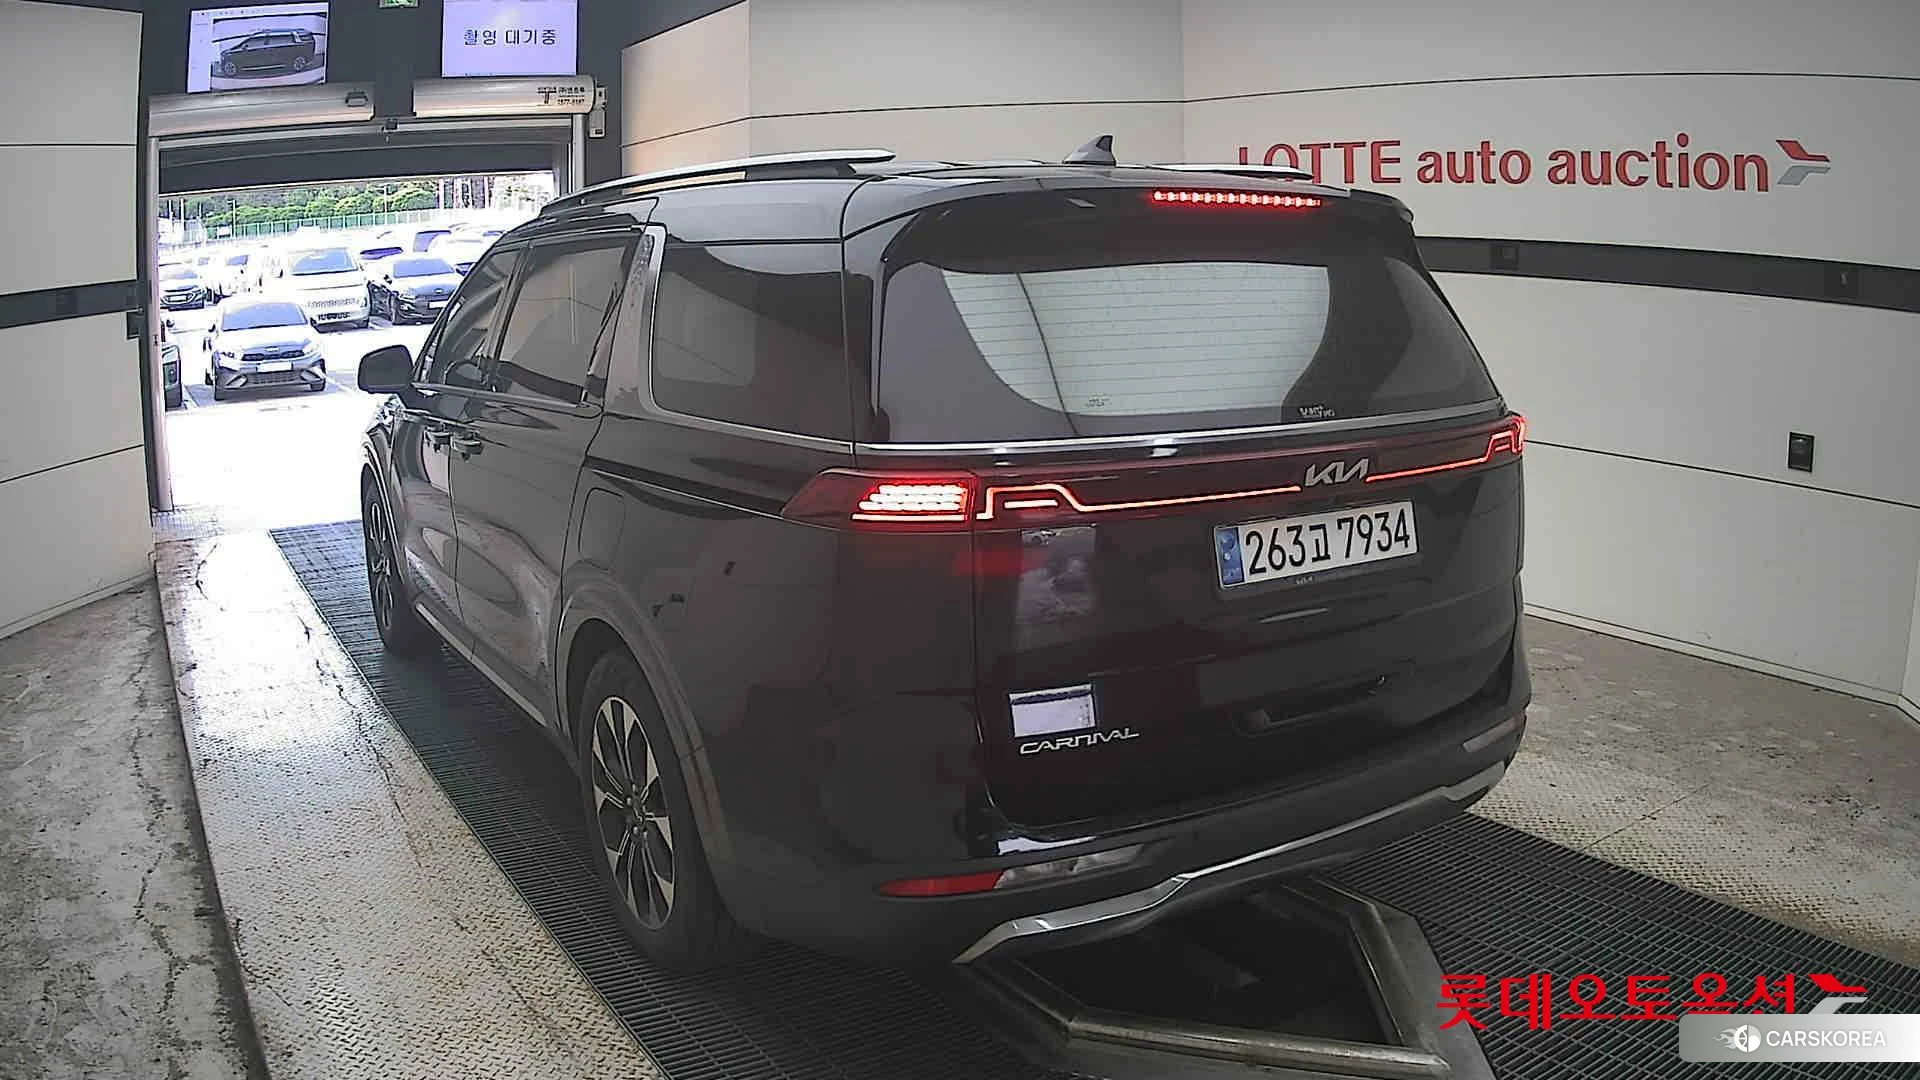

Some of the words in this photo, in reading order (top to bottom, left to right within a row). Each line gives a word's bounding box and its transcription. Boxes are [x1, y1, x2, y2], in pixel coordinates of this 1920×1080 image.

[505, 29, 556, 46] 대기중
[1416, 140, 1532, 185] auto
[1547, 133, 1769, 192] auction
[1305, 458, 1369, 487] KIA
[1245, 523, 1331, 575] 263고
[1337, 508, 1411, 559] 7934
[1020, 728, 1140, 755] CARNIVAL
